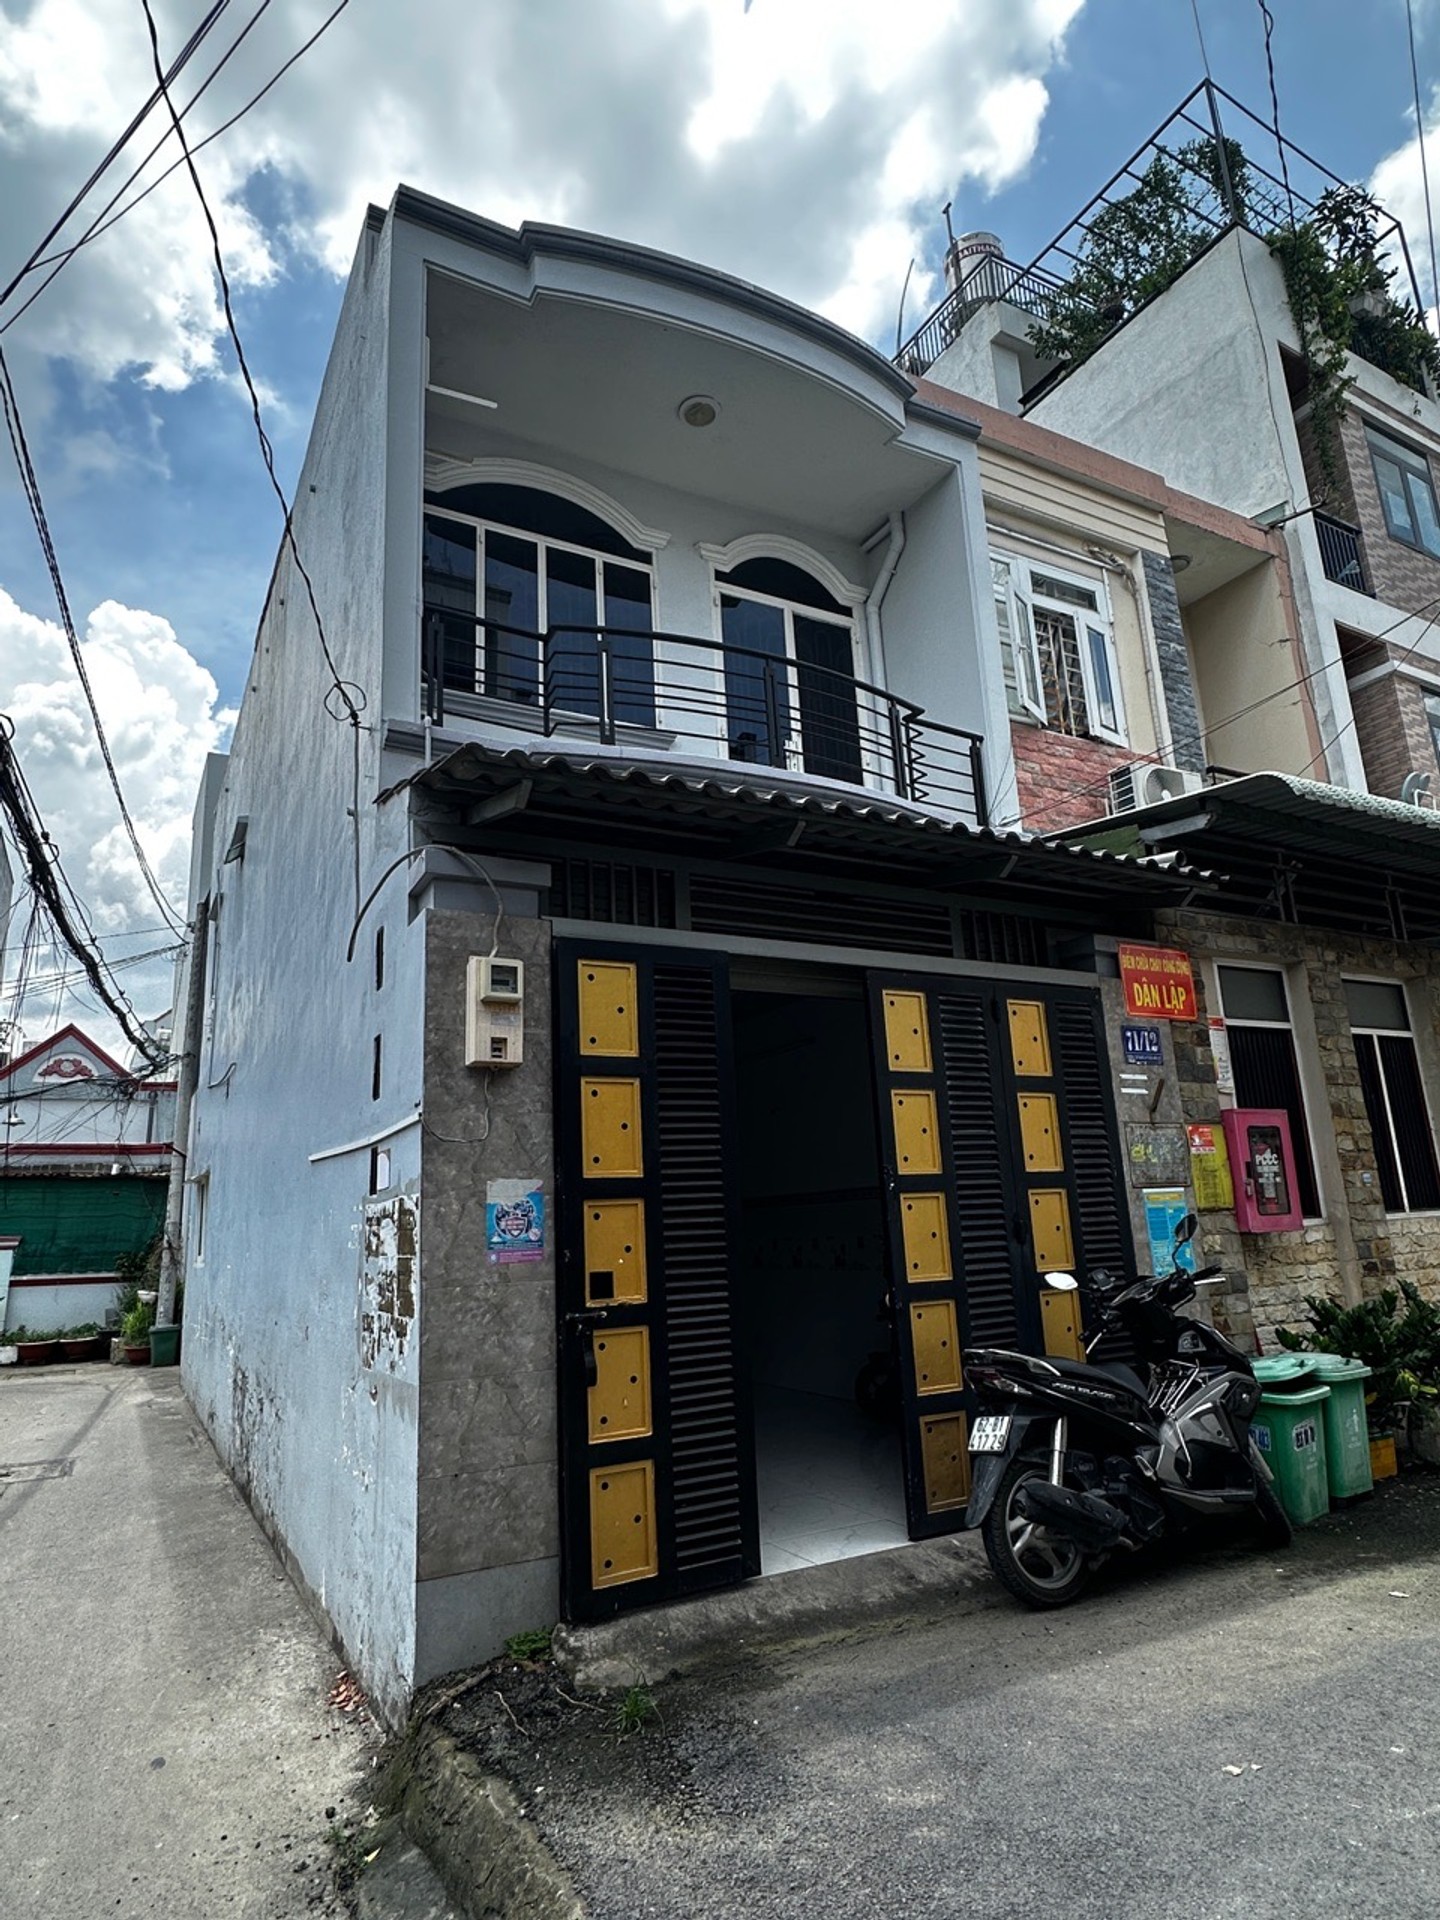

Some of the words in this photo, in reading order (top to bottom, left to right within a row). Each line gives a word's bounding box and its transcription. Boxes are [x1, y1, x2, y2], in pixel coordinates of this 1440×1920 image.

[1133, 976, 1161, 1008] DÂN
[1162, 979, 1187, 1015] LẬP
[1125, 1030, 1159, 1052] 71/12
